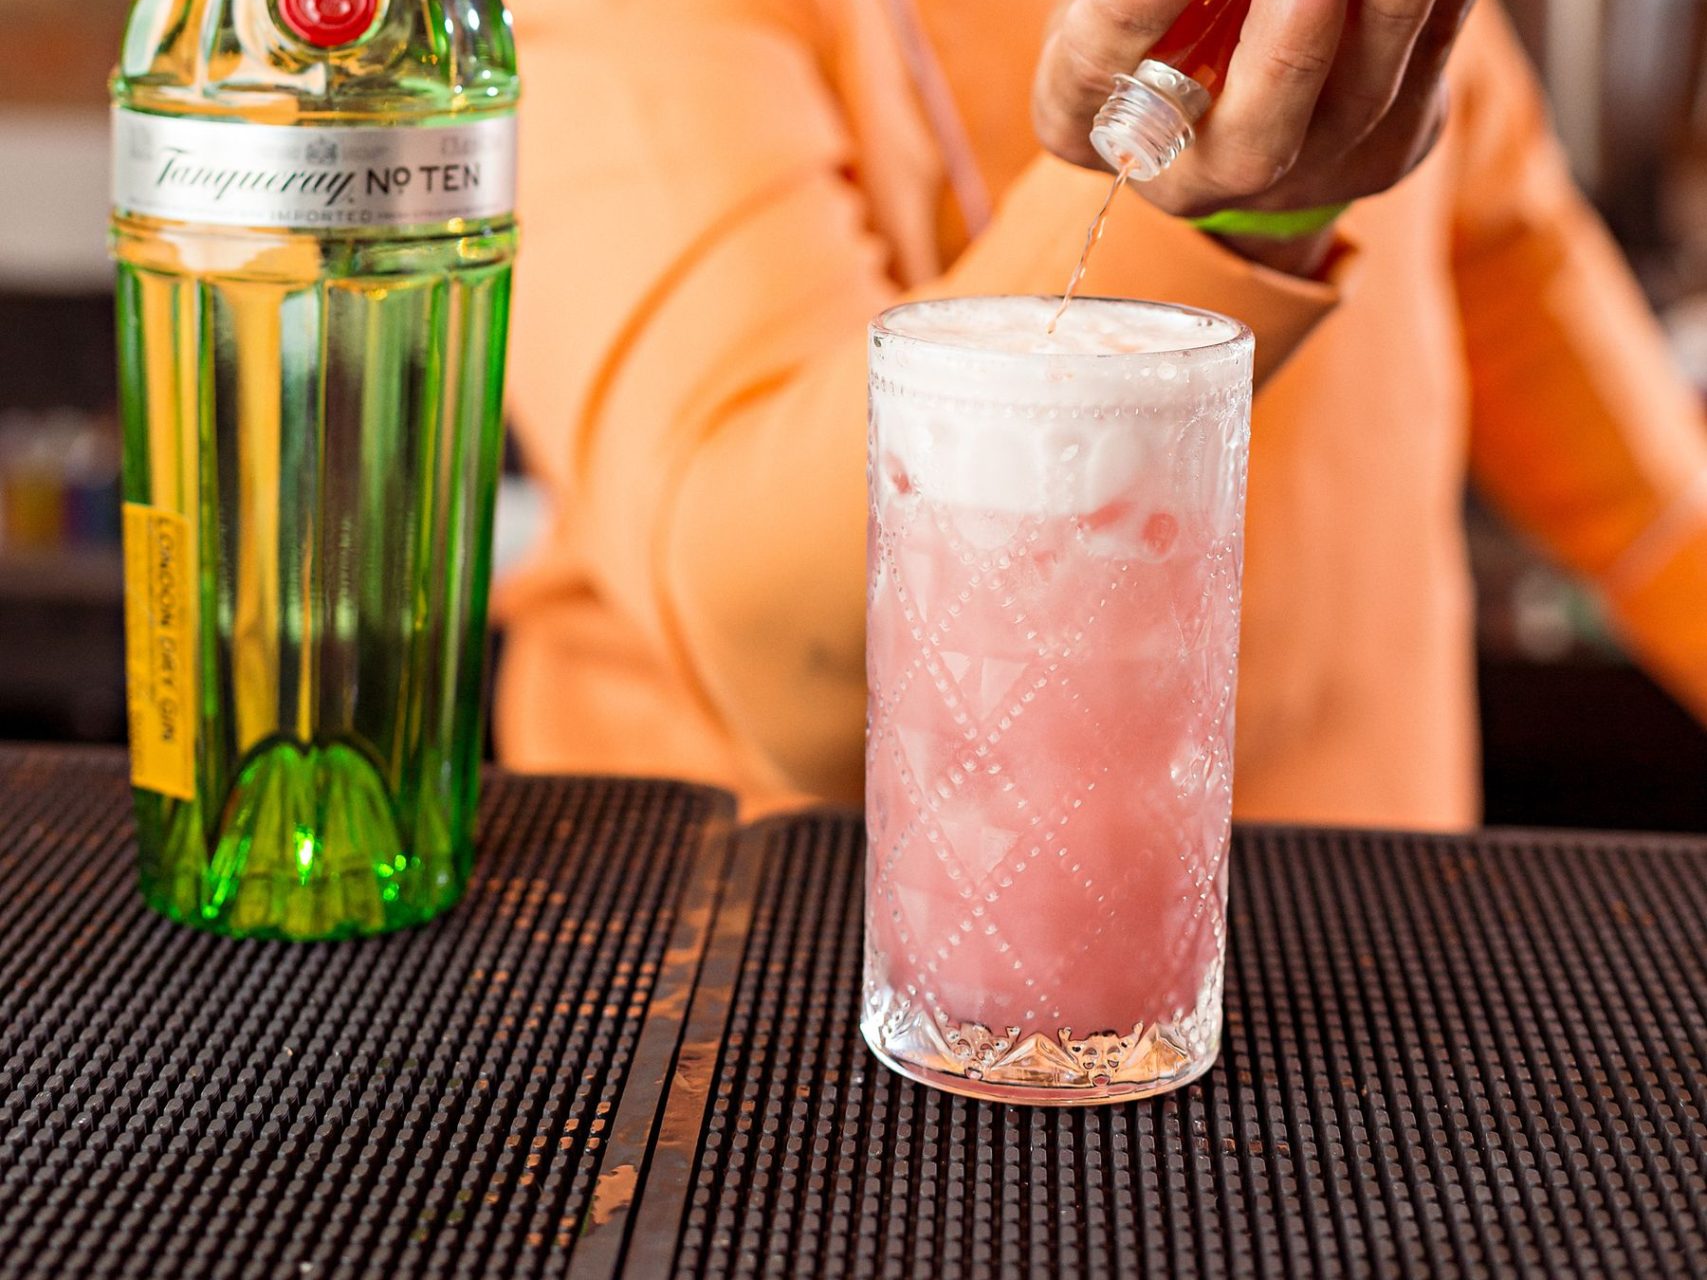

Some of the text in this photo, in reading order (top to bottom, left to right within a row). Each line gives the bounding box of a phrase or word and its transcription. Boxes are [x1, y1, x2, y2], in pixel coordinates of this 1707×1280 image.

[418, 163, 481, 193] TEN
[270, 208, 374, 224] IMPORTED
[158, 517, 178, 742] LONDON DRY GIN
